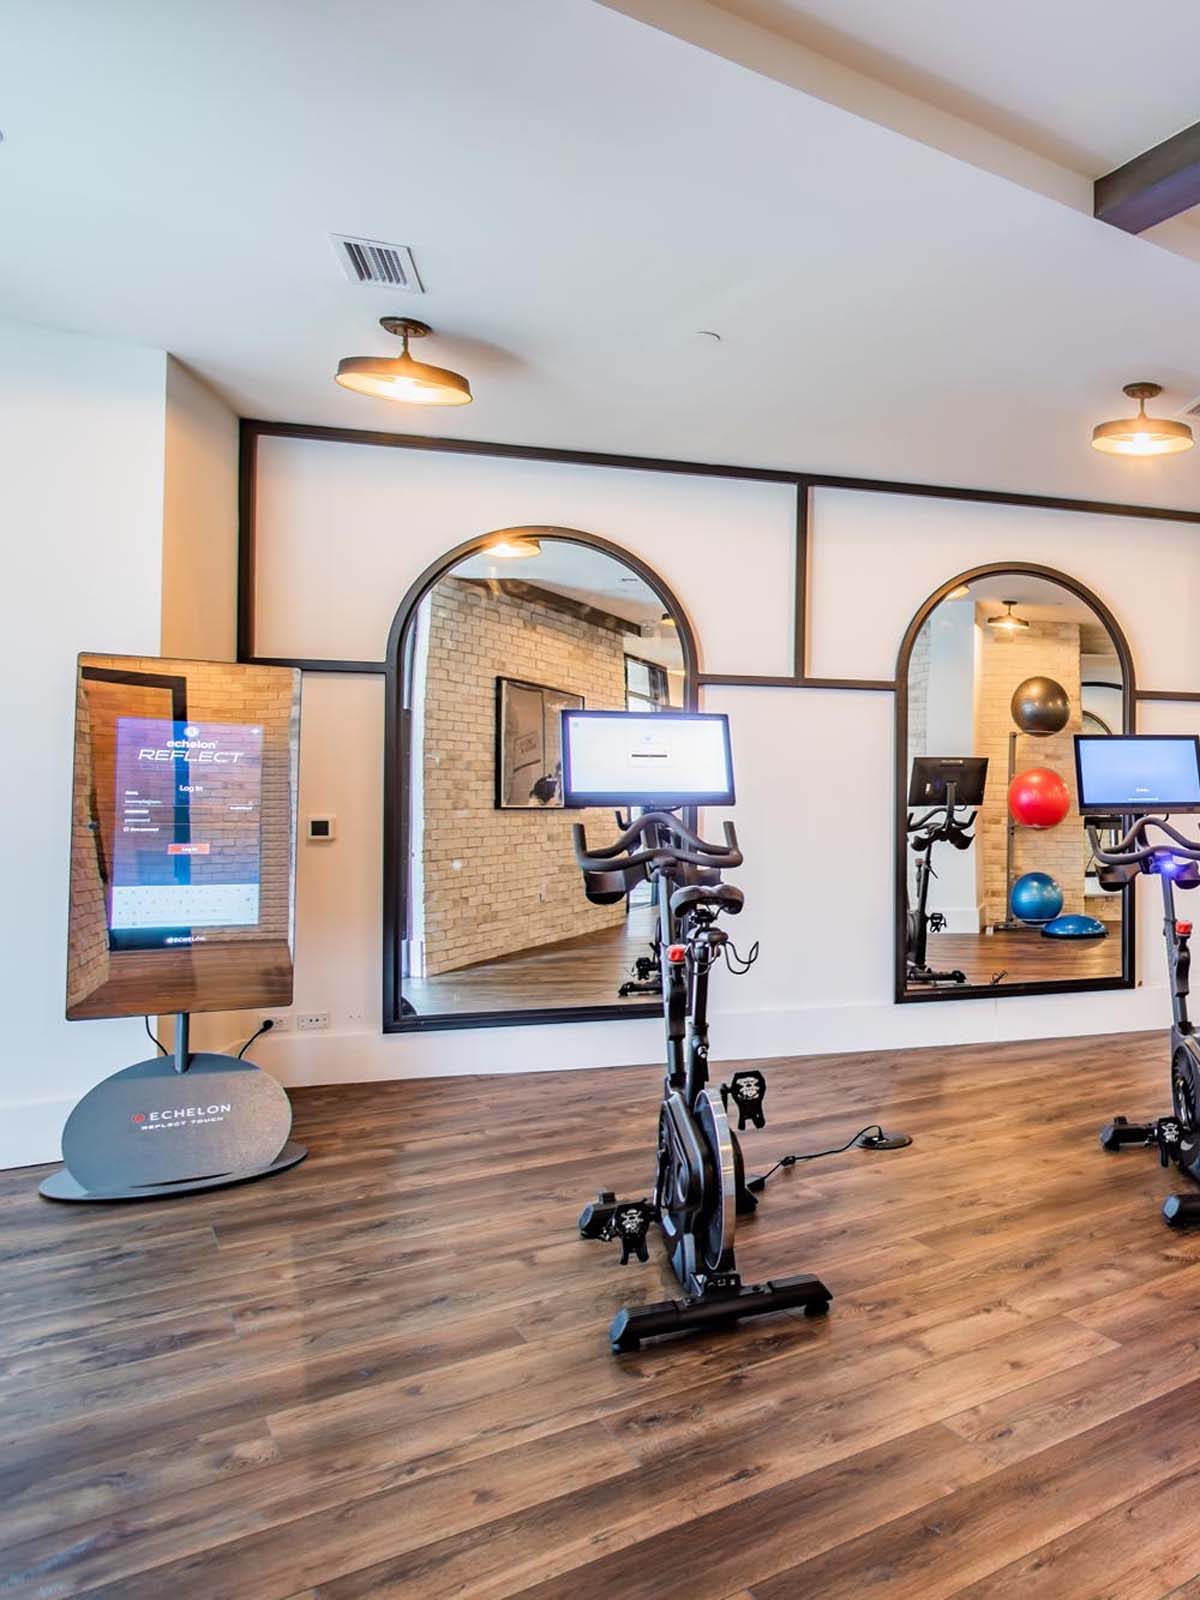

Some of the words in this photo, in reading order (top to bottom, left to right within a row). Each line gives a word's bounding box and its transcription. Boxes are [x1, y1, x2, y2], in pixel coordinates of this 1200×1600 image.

[138, 749, 244, 763] REFLECT
[149, 1103, 232, 1121] ECHELON
[141, 1120, 187, 1130] REFLECT
[190, 1116, 225, 1125] TOUCH
